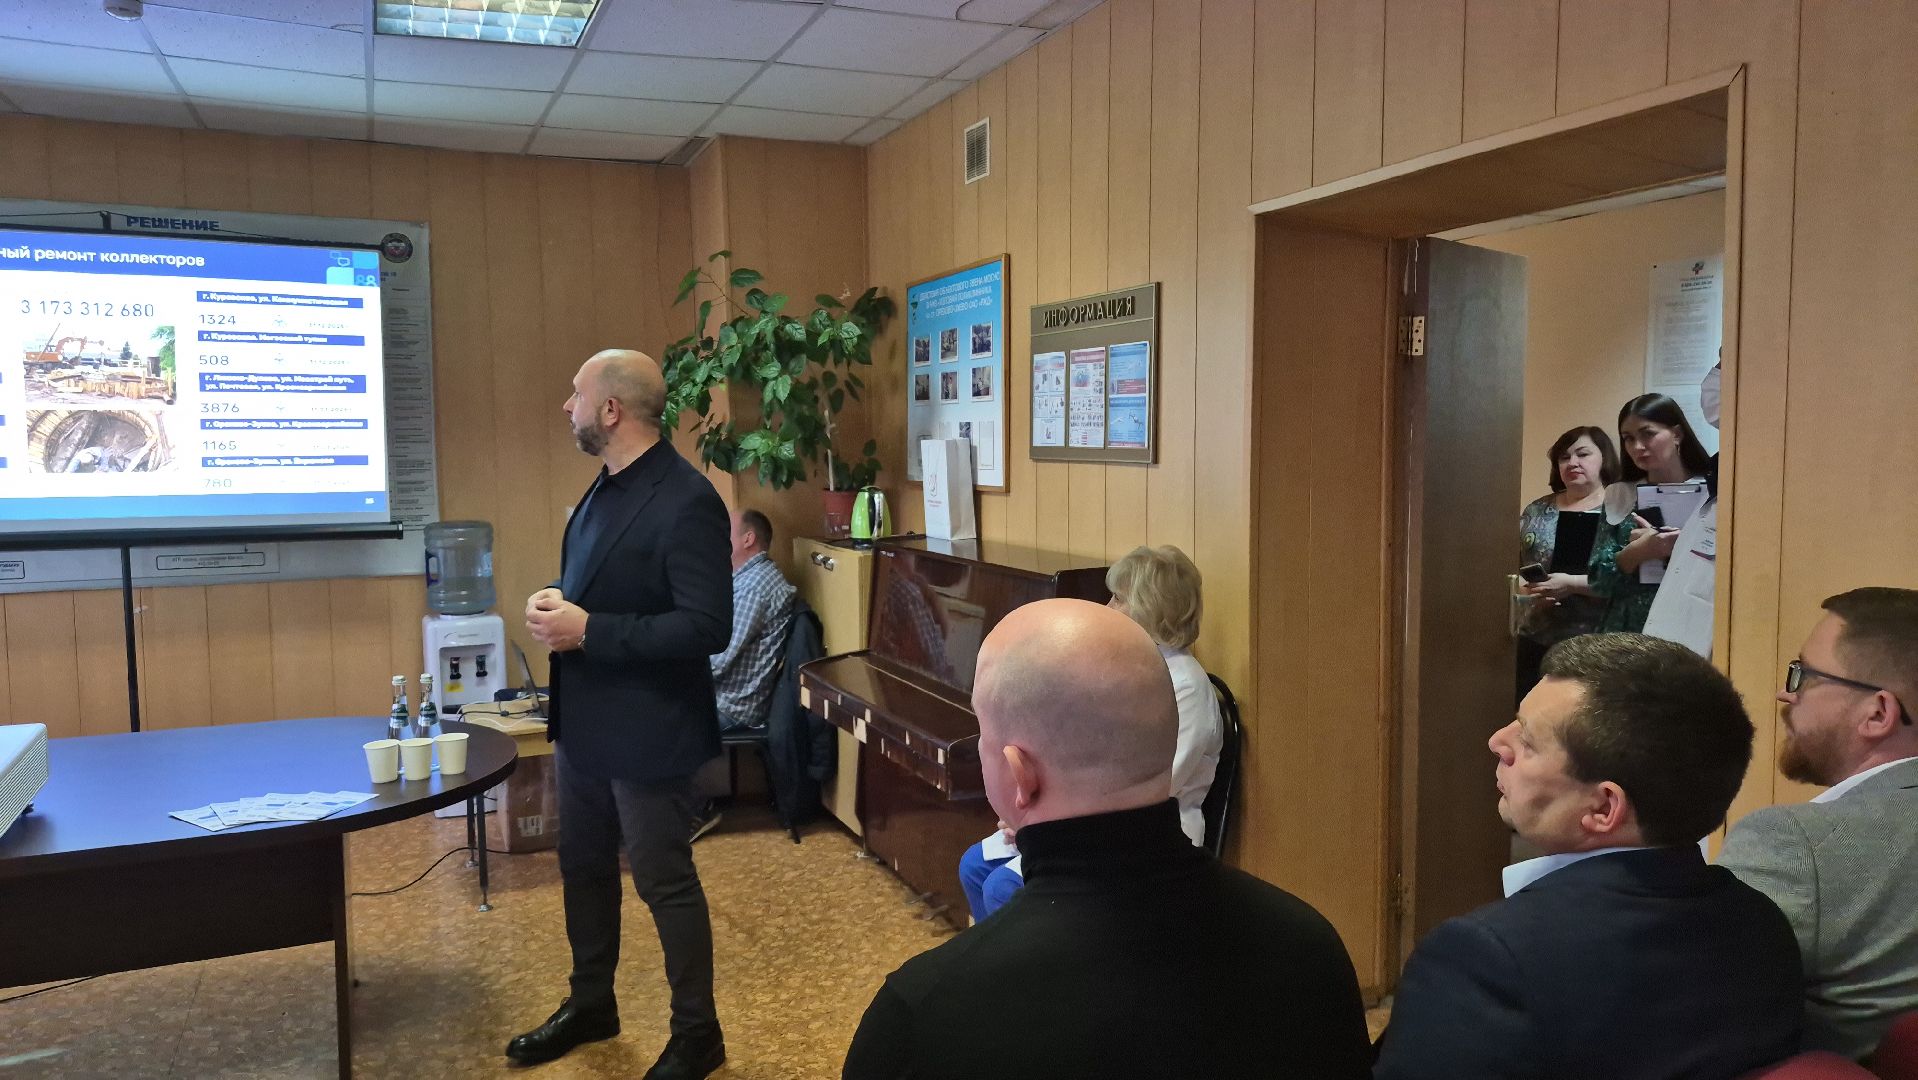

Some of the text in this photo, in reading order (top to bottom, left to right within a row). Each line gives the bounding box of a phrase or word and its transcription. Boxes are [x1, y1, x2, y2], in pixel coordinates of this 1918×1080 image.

[126, 216, 220, 231] РЕШЕНИЕ
[34, 248, 96, 262] ремонт
[100, 252, 205, 268] коллекторов
[21, 300, 154, 317] 3 173 312 680
[1043, 296, 1135, 328] ИНФОРМАЦИЯ
[199, 314, 236, 325] 1324
[199, 355, 229, 366] 508
[200, 402, 240, 413] 3876
[202, 440, 237, 450] 1165
[203, 478, 232, 488] 780
